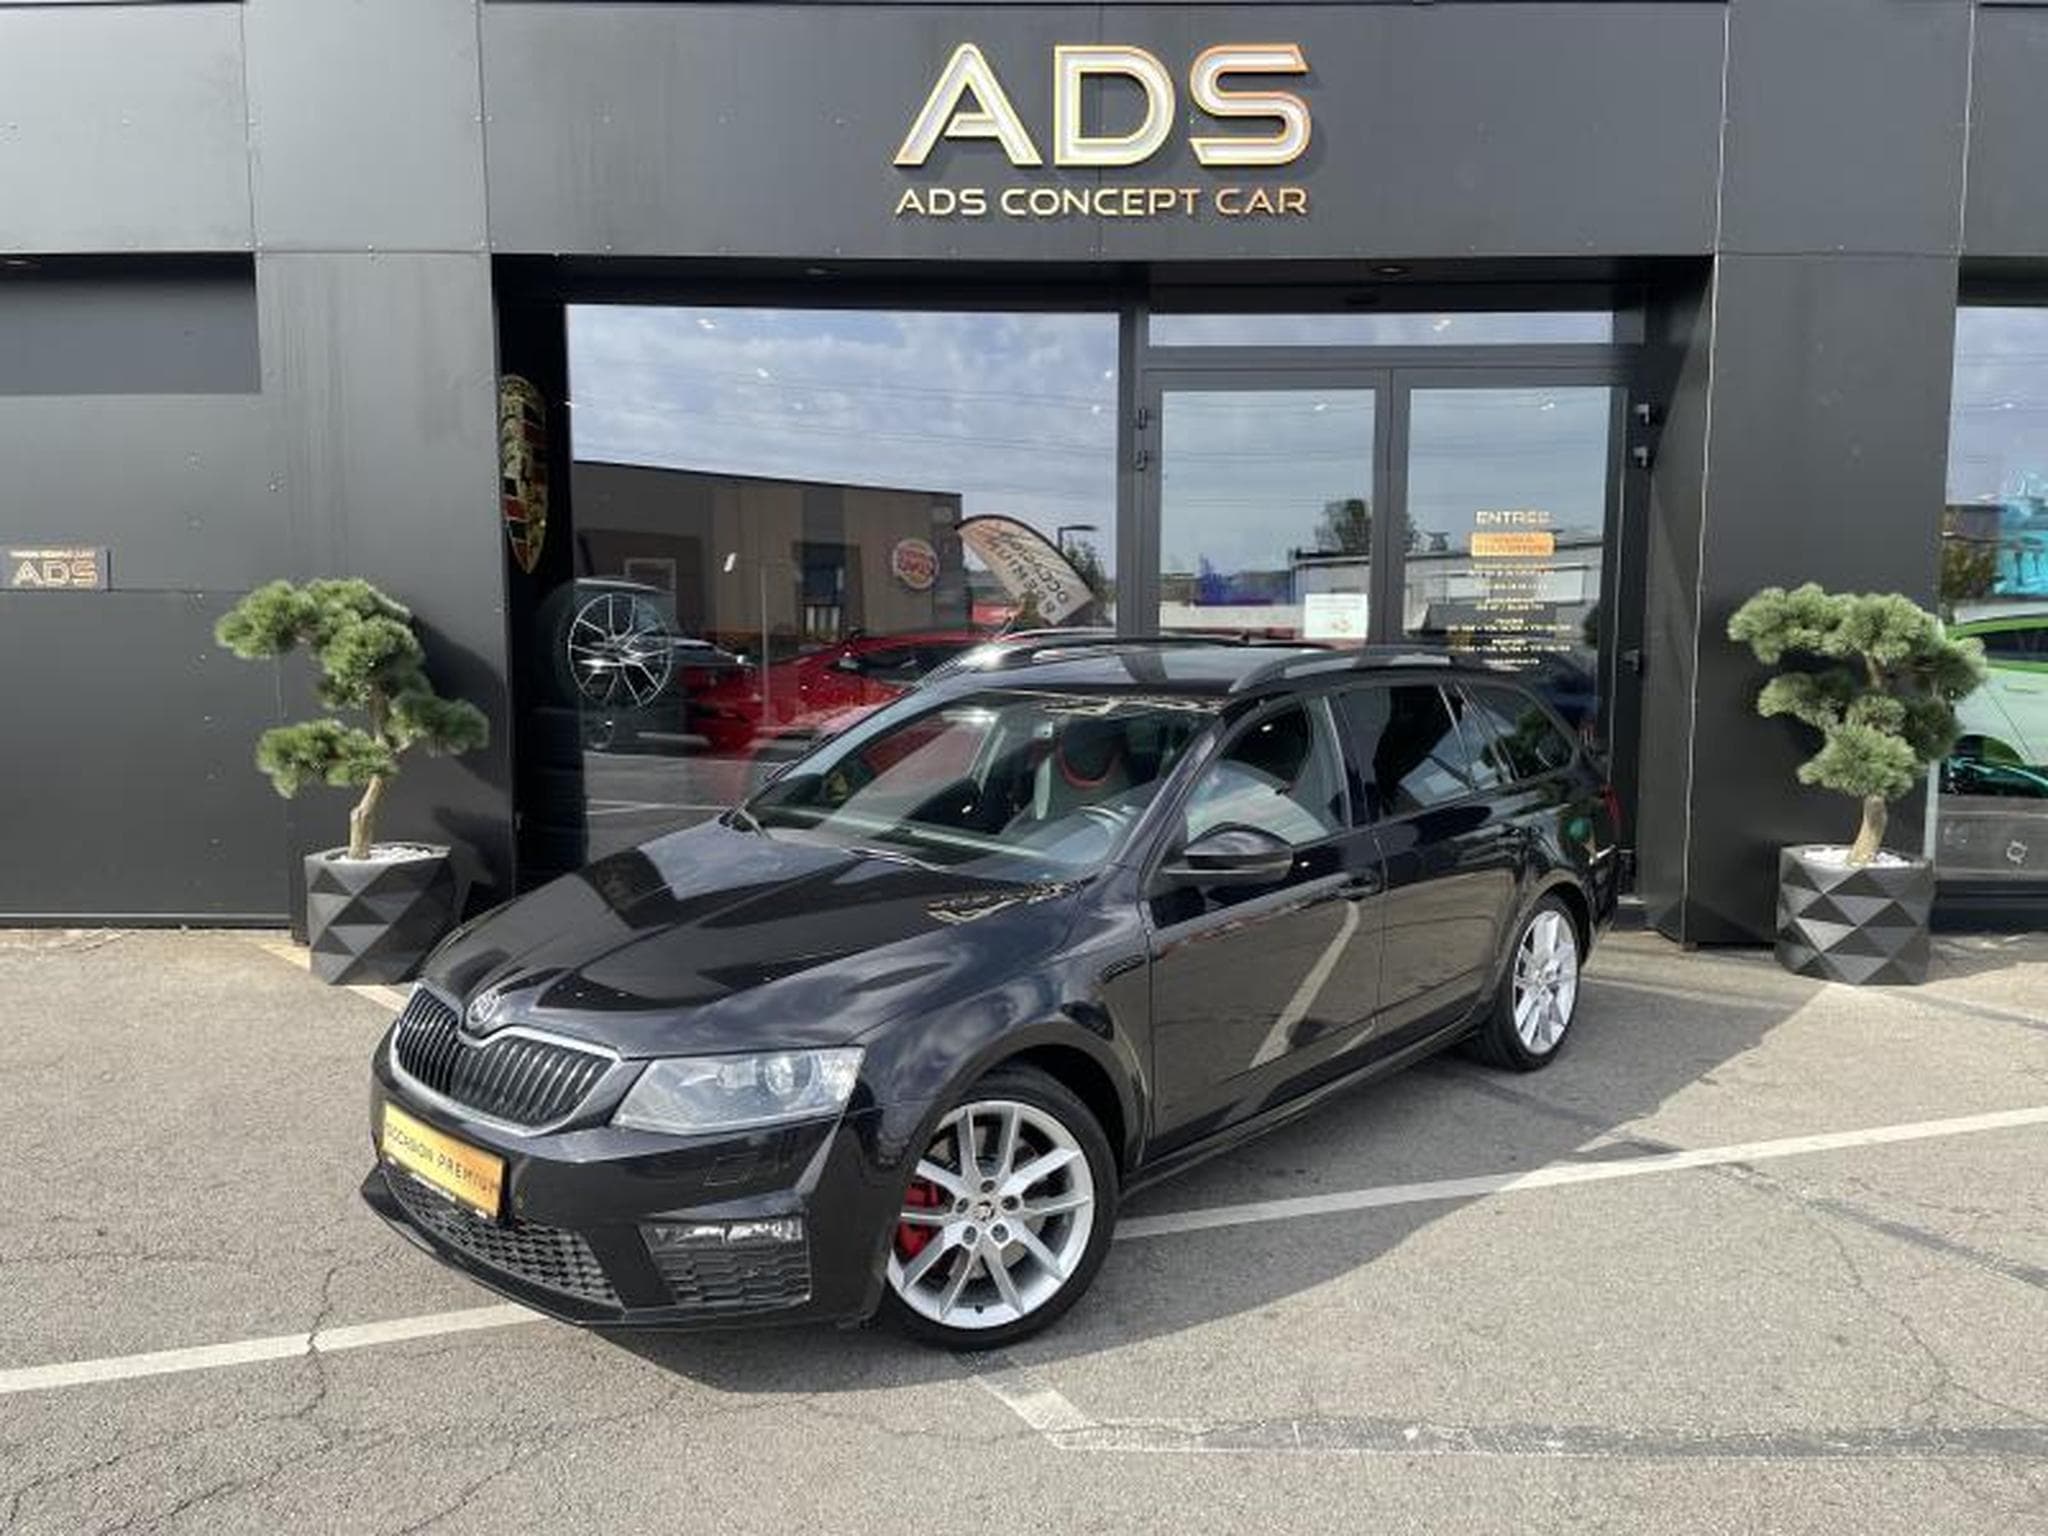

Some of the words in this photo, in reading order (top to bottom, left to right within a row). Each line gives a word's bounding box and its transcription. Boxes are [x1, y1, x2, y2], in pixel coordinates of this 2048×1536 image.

[894, 42, 1312, 166] ADS
[895, 188, 986, 216] ADS
[1001, 188, 1199, 216] CONCEPT
[1215, 188, 1307, 216] CAR
[12, 559, 98, 586] ADS
